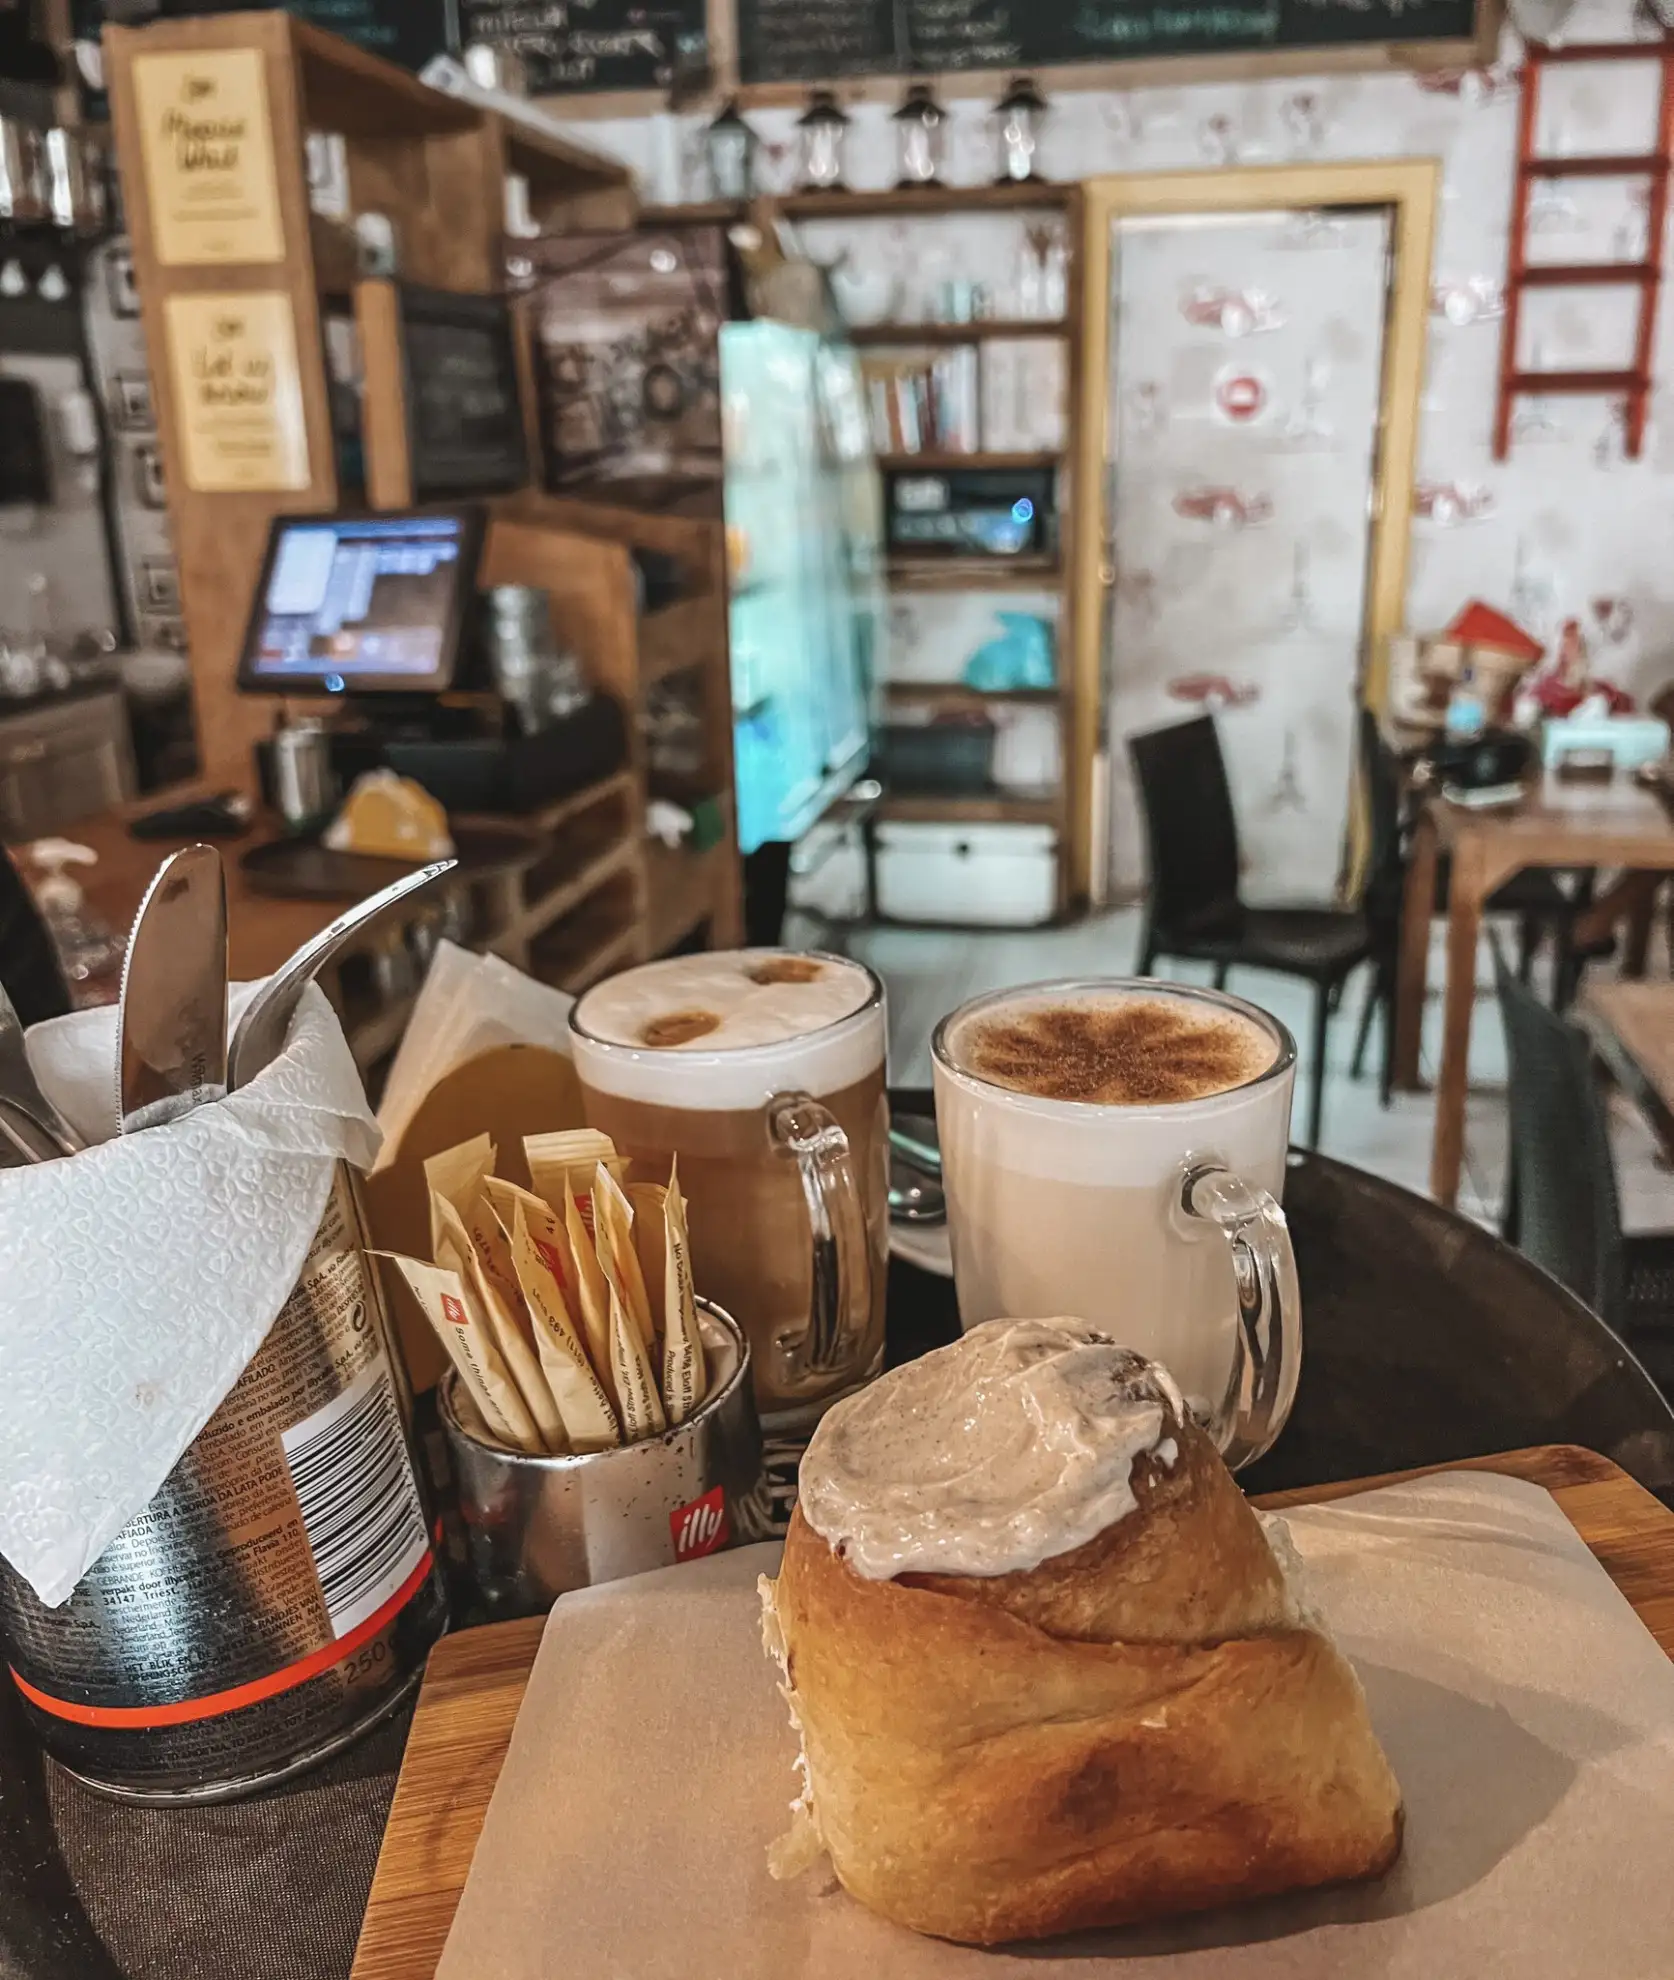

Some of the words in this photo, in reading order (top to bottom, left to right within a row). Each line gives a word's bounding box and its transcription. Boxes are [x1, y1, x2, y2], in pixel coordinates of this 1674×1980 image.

[455, 1327, 473, 1359] Some
[664, 1351, 677, 1393] Produced
[246, 1395, 289, 1421] embalado
[199, 1429, 246, 1452] Embalado
[249, 1420, 264, 1432] em
[228, 1430, 263, 1452] Sucursal
[265, 1426, 276, 1436] en
[173, 1507, 180, 1516] A
[181, 1496, 217, 1514] BORDA
[218, 1489, 233, 1501] DA
[233, 1480, 258, 1495] LATA
[258, 1466, 283, 1484] PODE
[131, 1534, 165, 1548] Depois
[678, 1503, 723, 1553] illy
[96, 1571, 143, 1586] GEBRANDE
[287, 1519, 298, 1528] en
[119, 1558, 155, 1571] superior
[100, 1585, 135, 1601] verpakt
[138, 1581, 161, 1590] door
[103, 1592, 134, 1605] 34147
[299, 1593, 318, 1607] VAN
[122, 1608, 171, 1623] Nederland
[124, 1663, 143, 1672] HET
[149, 1658, 174, 1669] BLIK
[260, 1614, 302, 1637] KUNNEN
[307, 1603, 321, 1615] NA
[344, 1641, 386, 1684] 250
